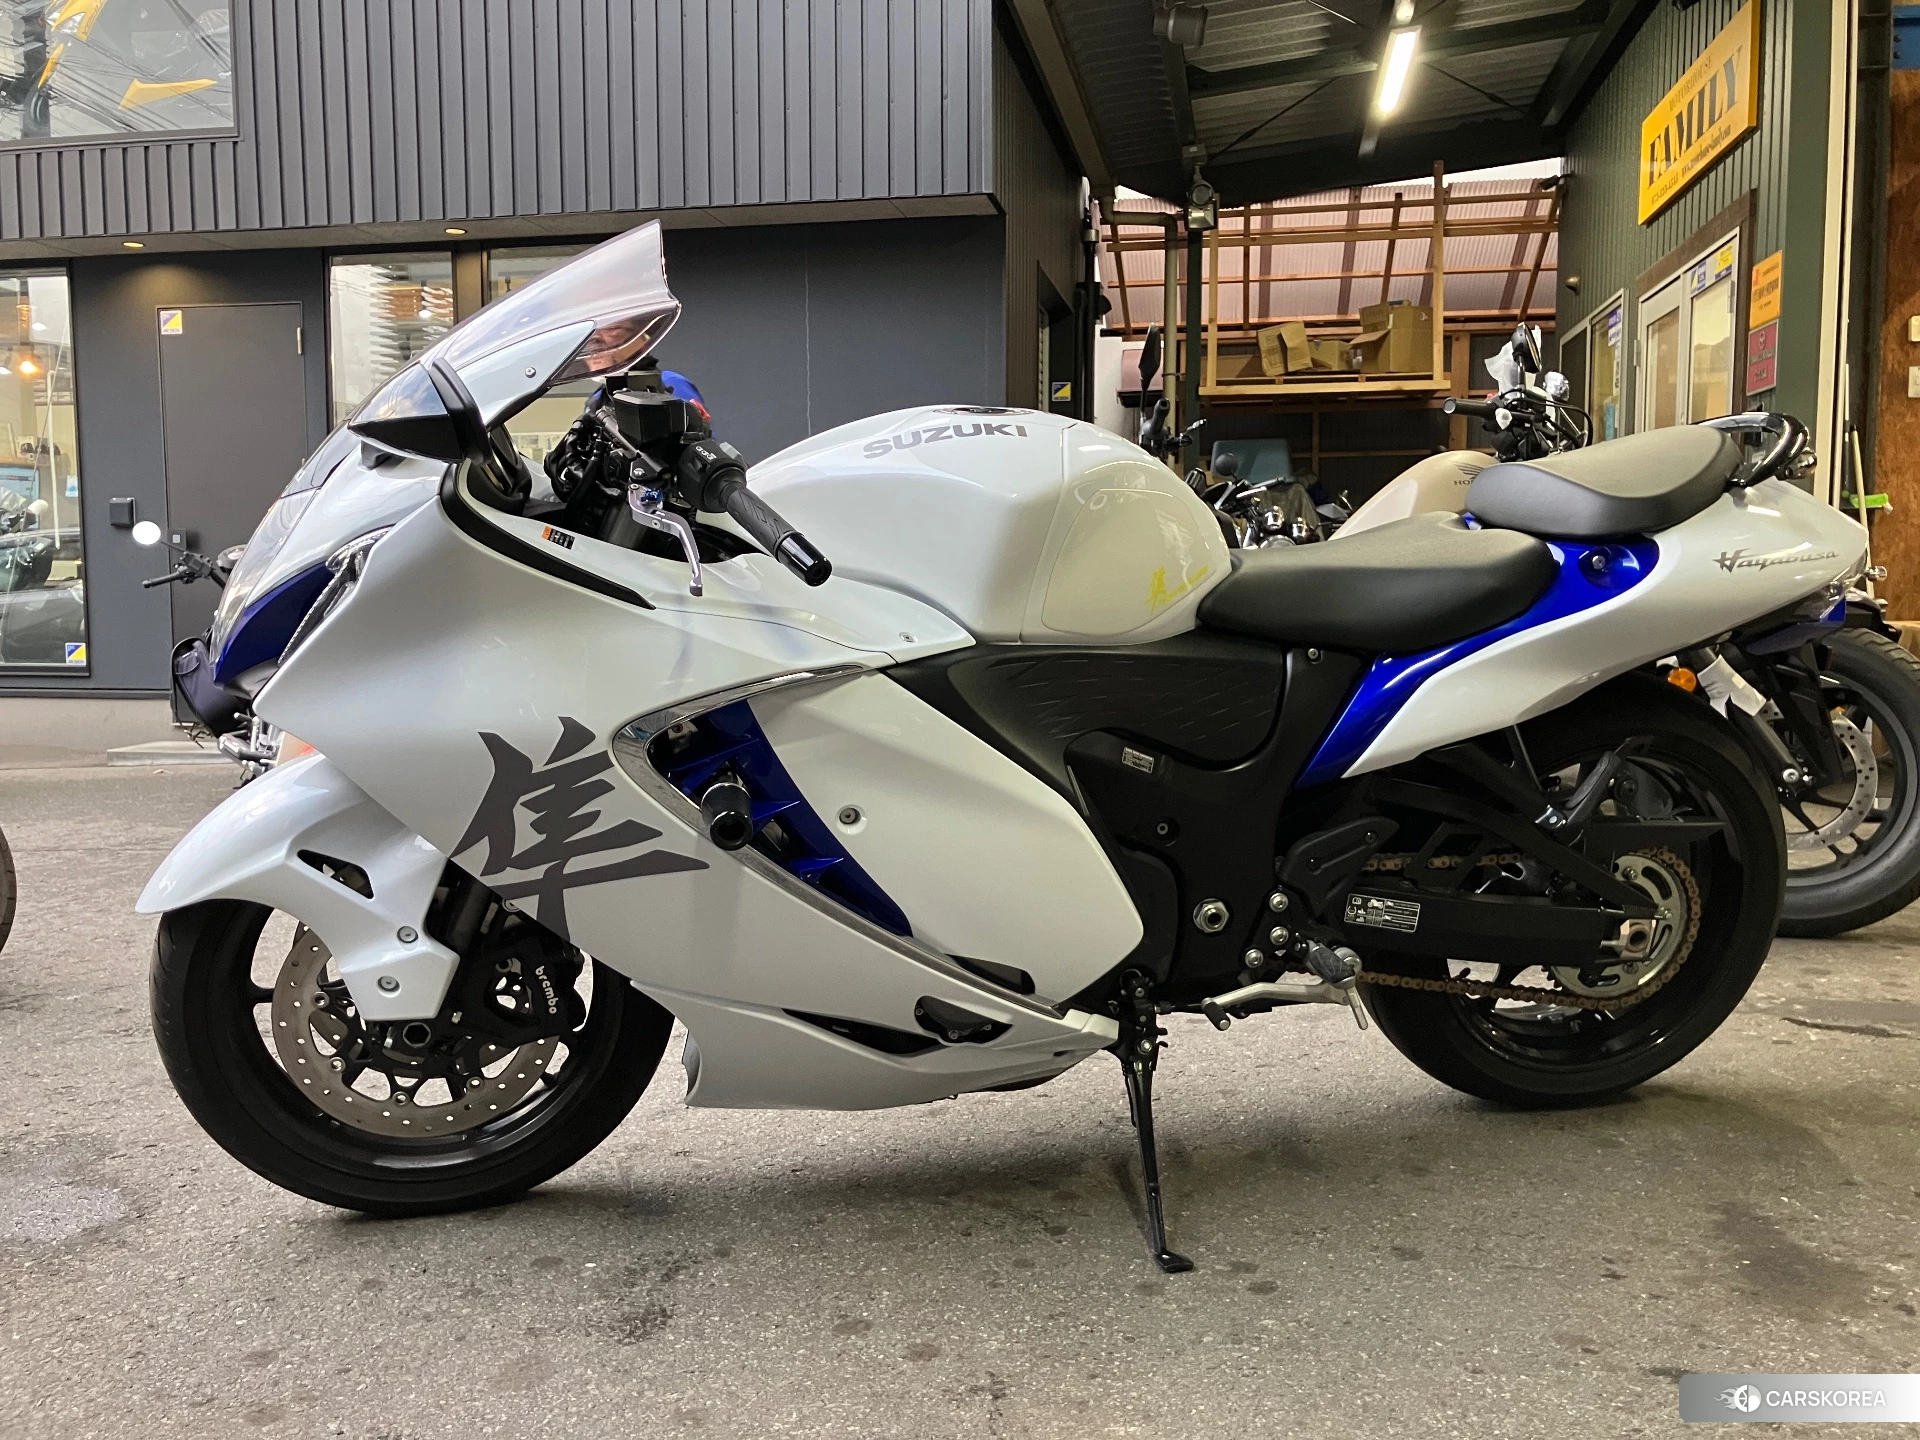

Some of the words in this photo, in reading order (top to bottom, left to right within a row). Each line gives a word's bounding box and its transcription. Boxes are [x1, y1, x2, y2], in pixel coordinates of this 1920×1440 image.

[1647, 45, 1743, 190] FAMILY
[863, 423, 1028, 460] SUZUKI
[1712, 547, 1839, 574] Hayabusa
[449, 716, 710, 943] 隼
[535, 965, 559, 1014] brembo
